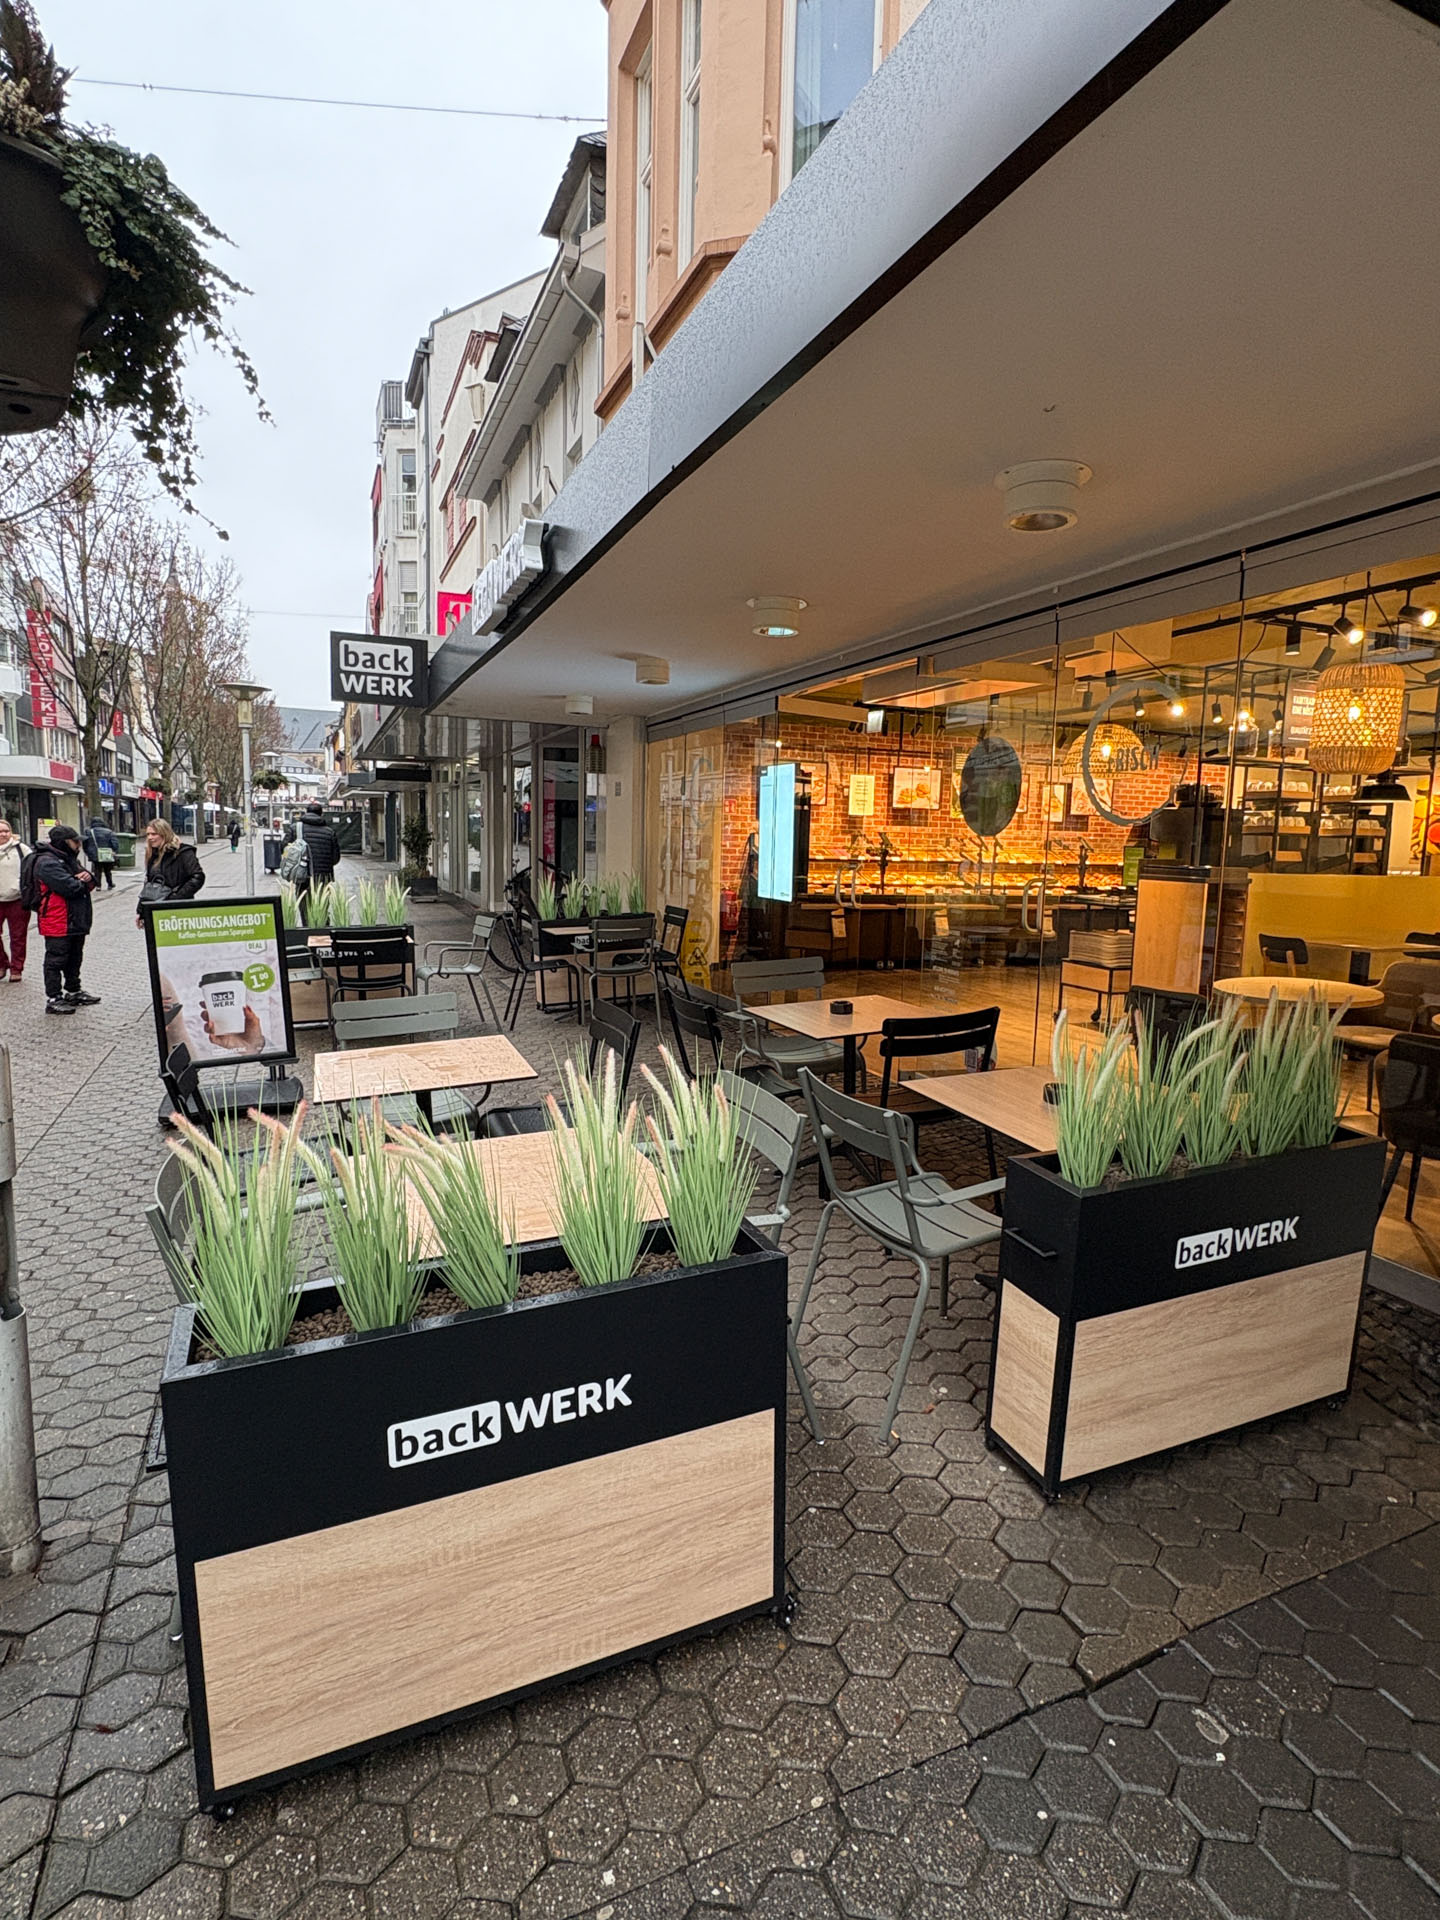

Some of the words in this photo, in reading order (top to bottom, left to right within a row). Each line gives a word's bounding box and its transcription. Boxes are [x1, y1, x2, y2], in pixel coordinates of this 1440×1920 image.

[343, 642, 409, 673] back
[339, 672, 414, 698] WERK
[211, 991, 235, 1002] back
[212, 1000, 235, 1009] WERK
